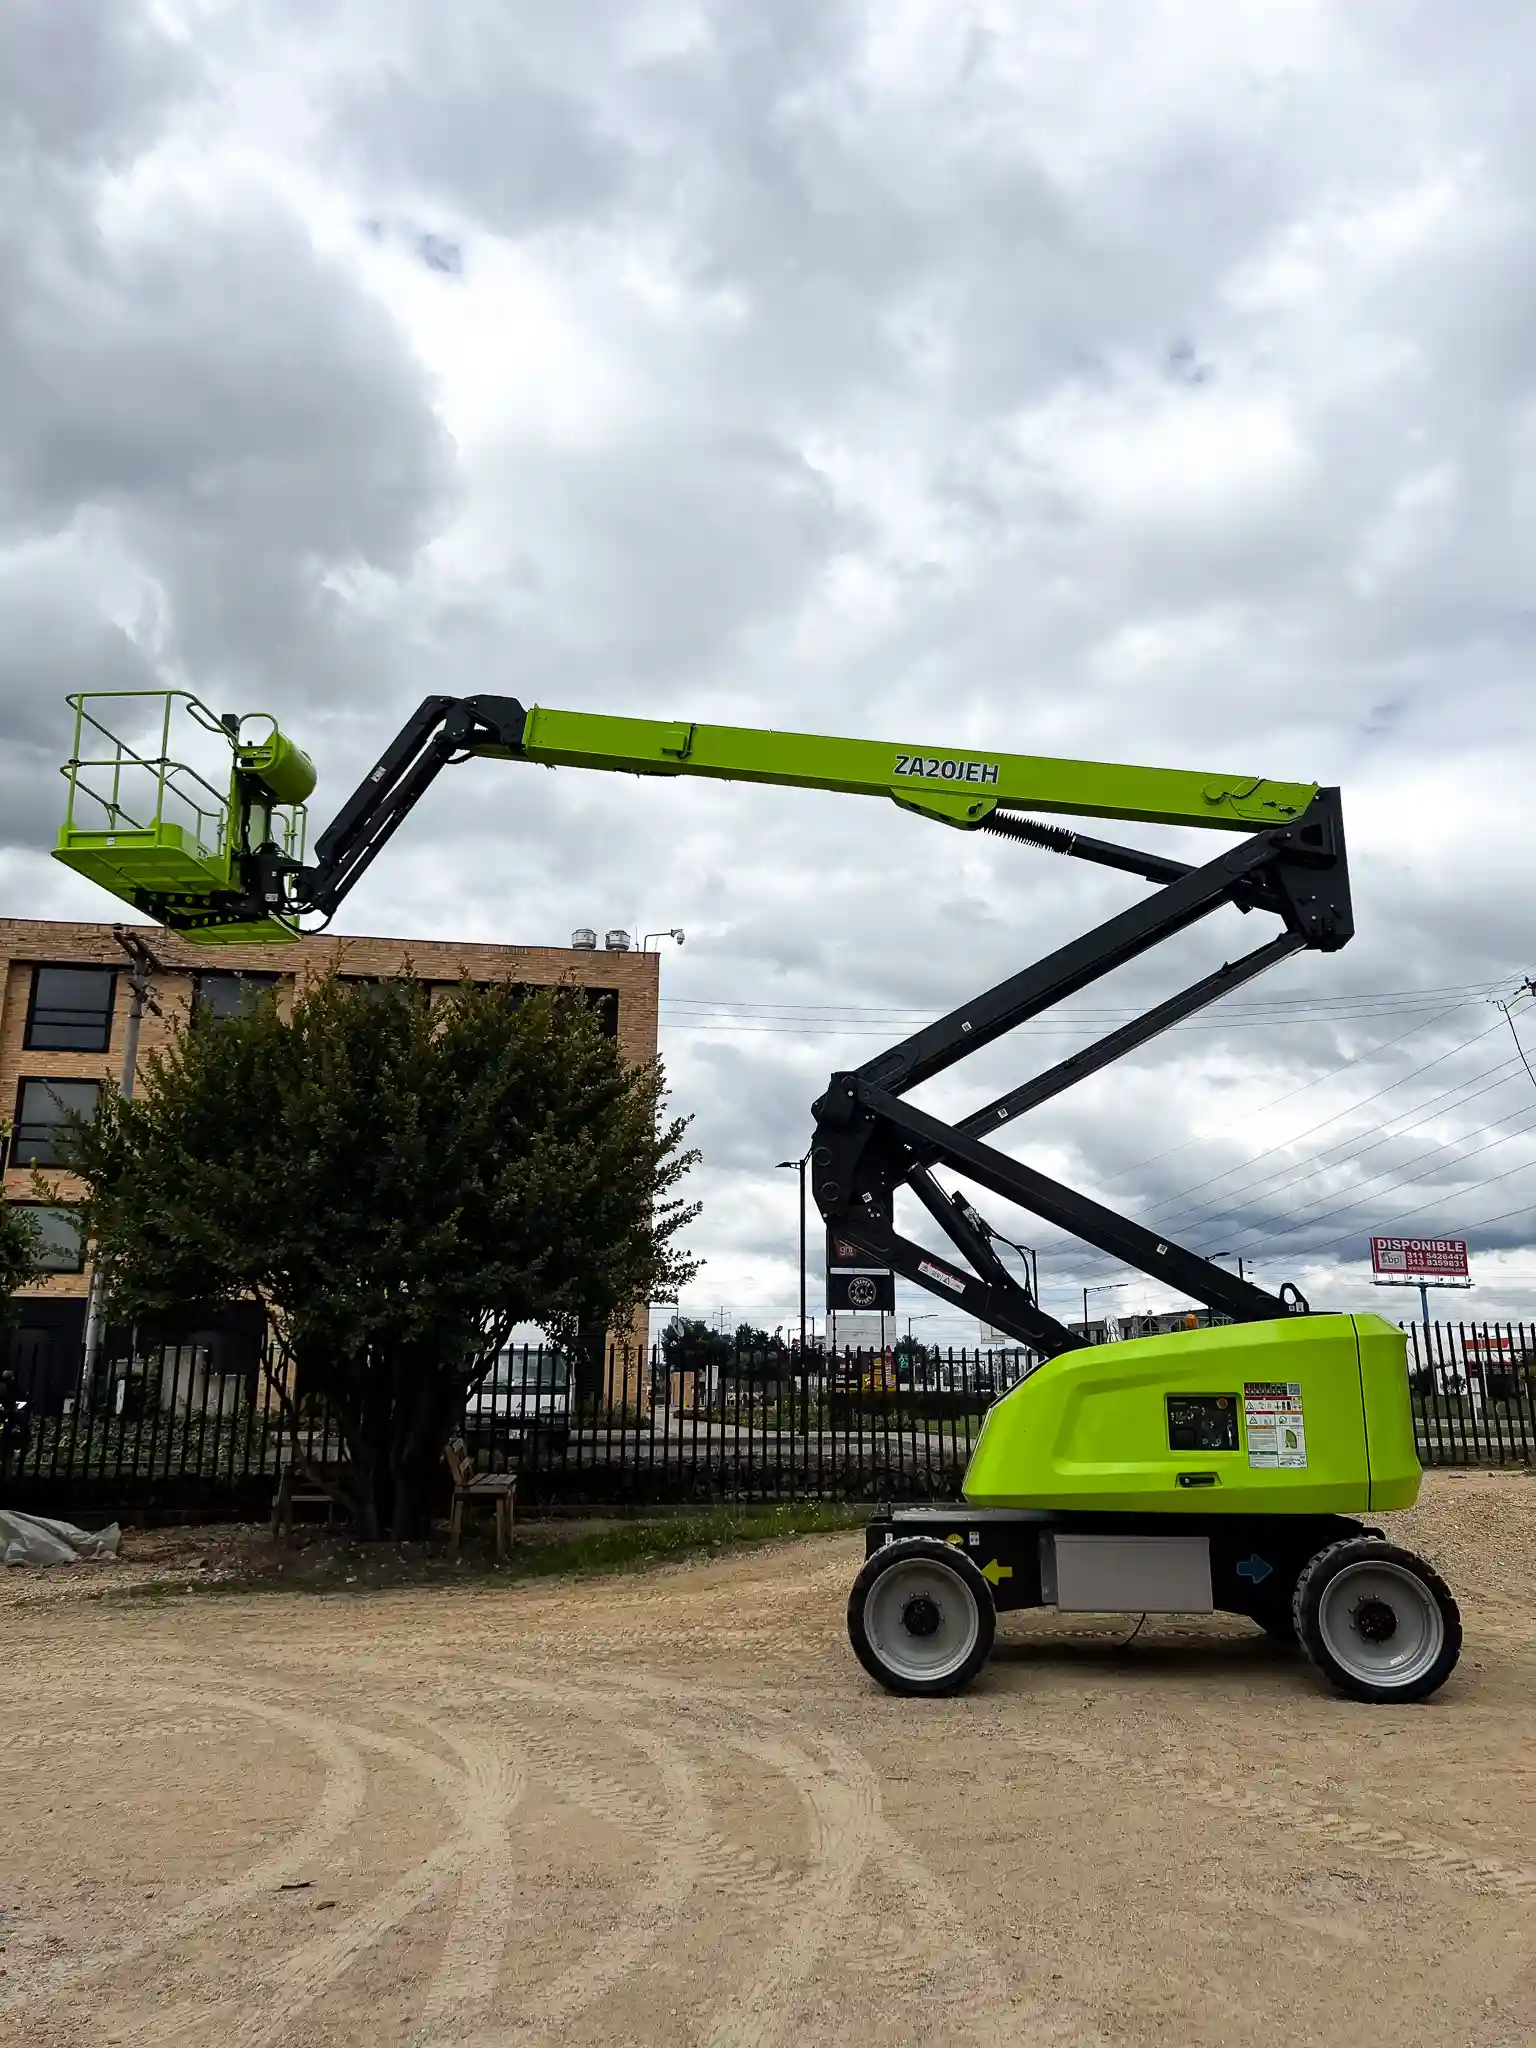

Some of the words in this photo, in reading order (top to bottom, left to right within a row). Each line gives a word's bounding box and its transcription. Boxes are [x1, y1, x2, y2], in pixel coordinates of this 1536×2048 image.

[893, 754, 1000, 785] ZA20JEH
[1377, 1239, 1464, 1252] DISPONIBLE
[1406, 1251, 1423, 1259] 311
[1407, 1258, 1424, 1266] 313
